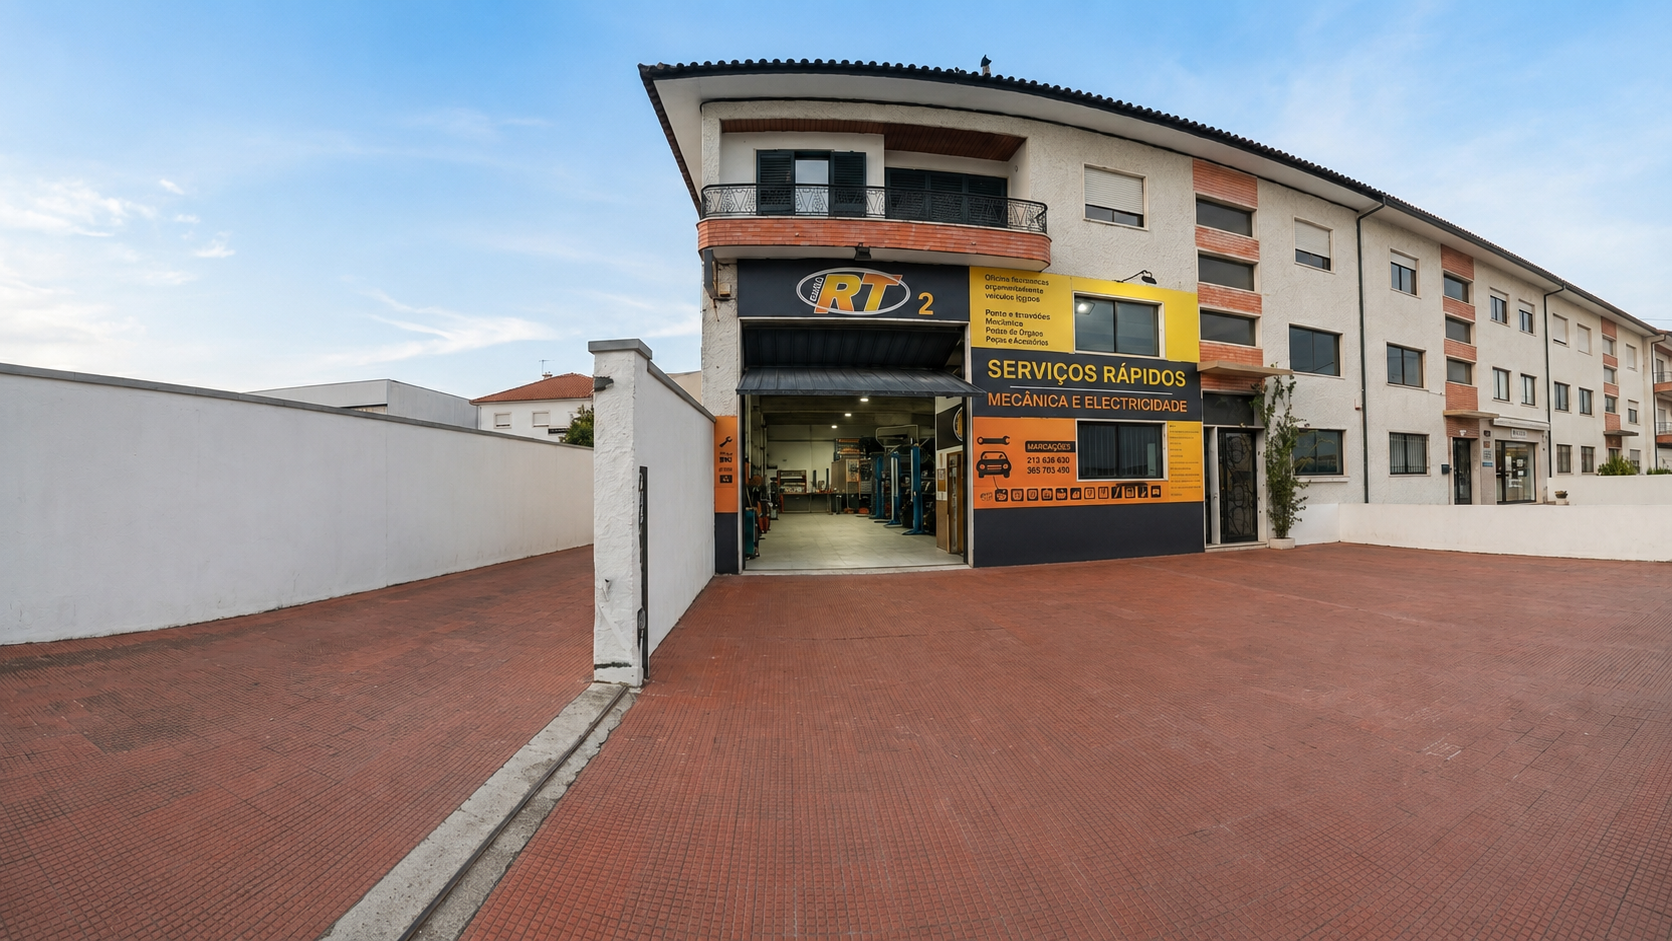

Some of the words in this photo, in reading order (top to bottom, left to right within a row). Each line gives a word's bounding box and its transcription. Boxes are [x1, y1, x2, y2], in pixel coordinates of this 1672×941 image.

[814, 272, 904, 314] RT
[918, 292, 934, 315] 2
[987, 359, 1098, 386] SERVIÇOS
[1103, 362, 1187, 388] RÁPIDOS
[987, 390, 1069, 408] MECÂNICA
[1072, 395, 1081, 409] E
[1084, 395, 1188, 413] ELECTRICIDADE
[1027, 442, 1071, 452] MARCAÇÕES
